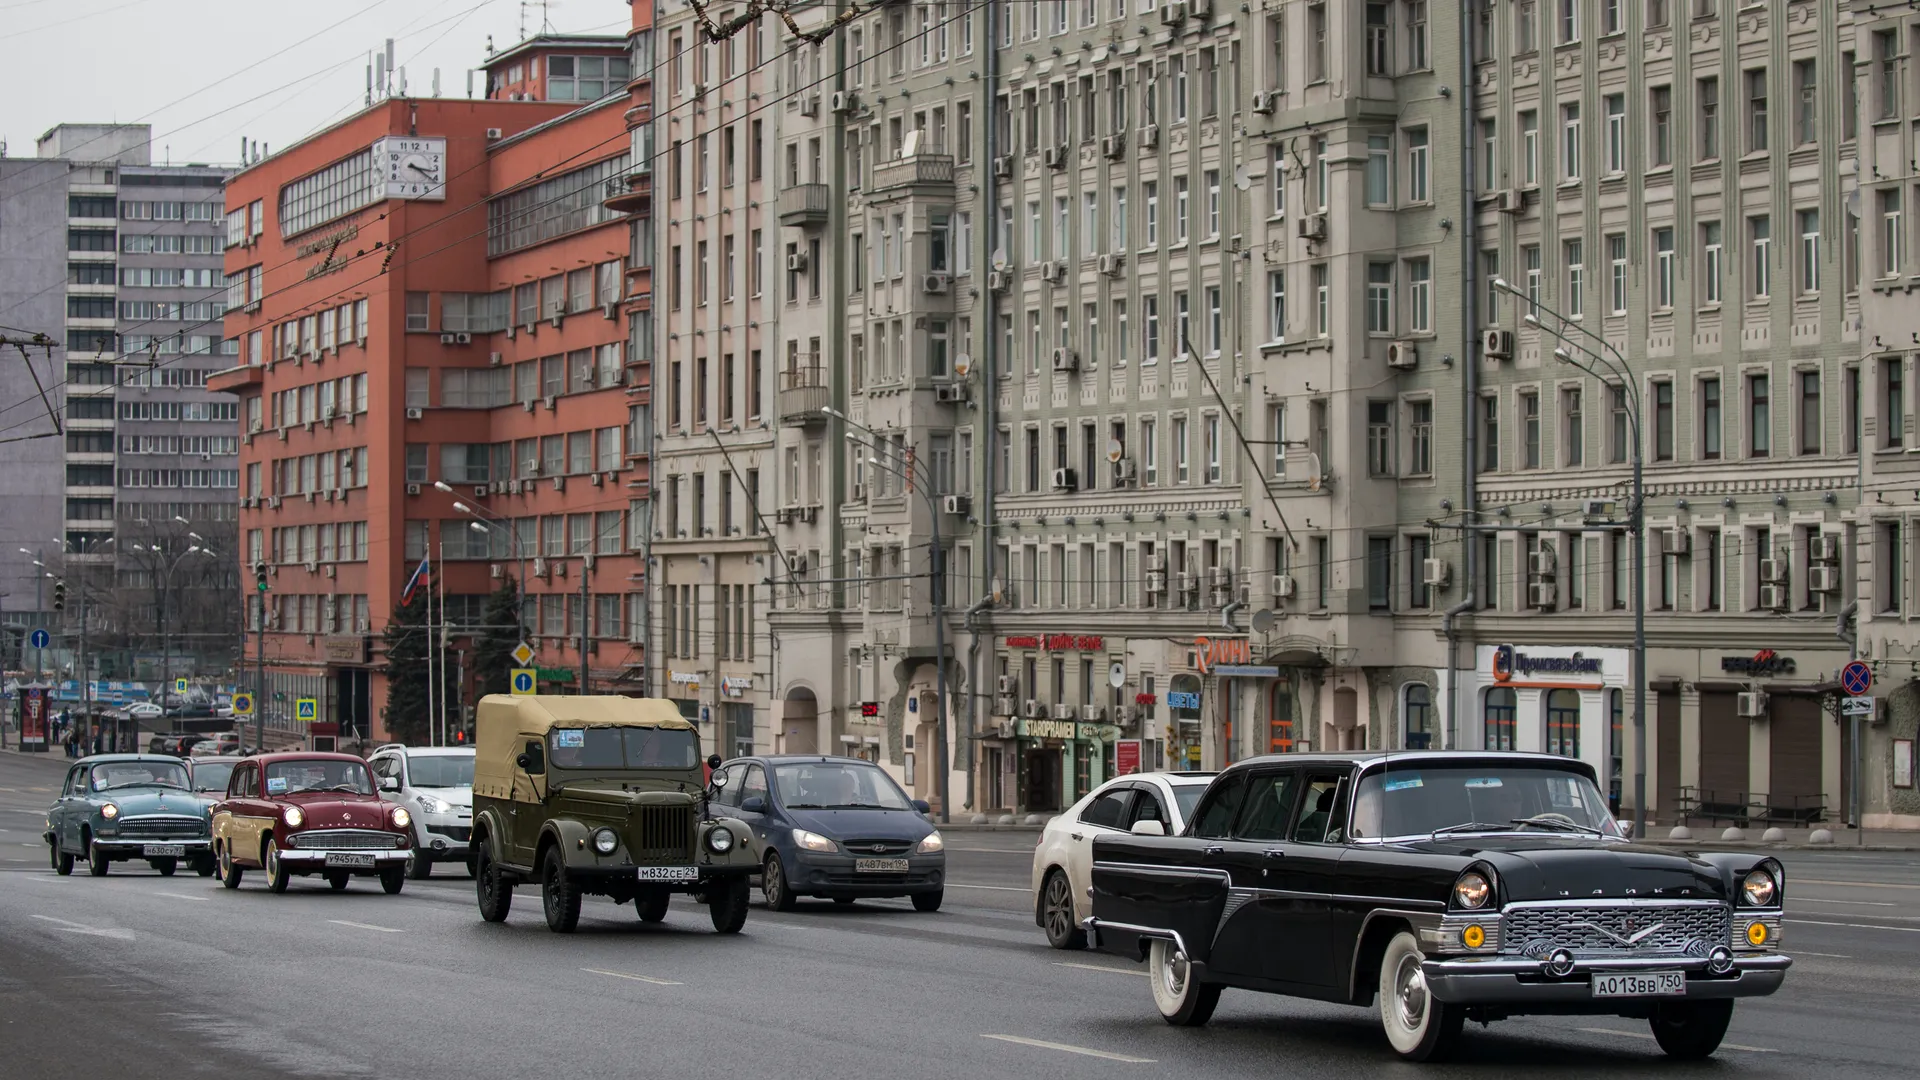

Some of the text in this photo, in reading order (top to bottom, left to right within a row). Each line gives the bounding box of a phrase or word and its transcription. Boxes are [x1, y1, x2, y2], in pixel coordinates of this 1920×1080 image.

[400, 142, 407, 150] 11
[411, 142, 420, 150] 12
[391, 153, 399, 161] 10
[392, 163, 397, 171] 9
[400, 185, 406, 193] 7
[412, 185, 418, 193] 6
[1515, 651, 1602, 675] Промсвязьбанк
[1167, 691, 1200, 709] ЦВЕТЫ
[1025, 720, 1076, 739] STAROPRAMEN
[685, 867, 695, 876] 29
[1598, 975, 1681, 994] А013ВВ 750
